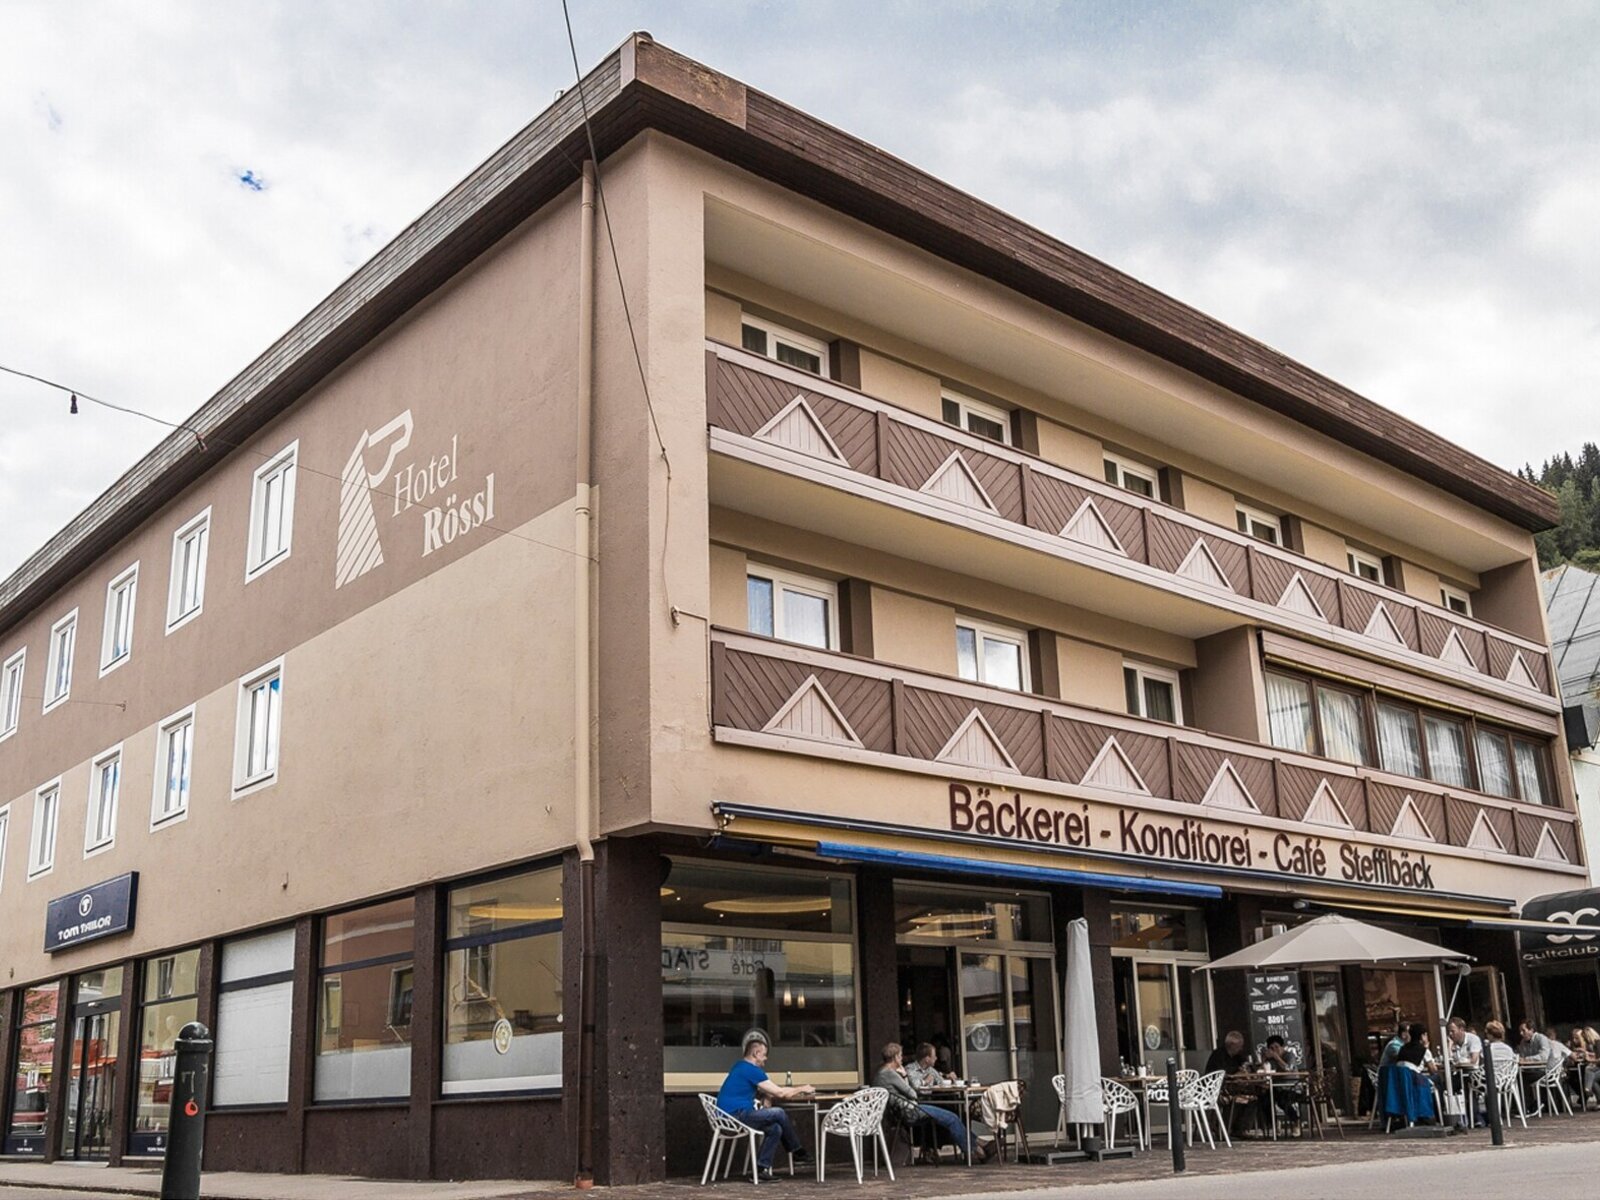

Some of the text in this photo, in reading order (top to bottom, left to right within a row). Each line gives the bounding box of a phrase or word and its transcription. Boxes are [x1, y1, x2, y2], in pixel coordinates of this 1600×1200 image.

[392, 434, 458, 518] Hotel
[421, 472, 495, 557] Rössl
[949, 783, 1091, 847] Bäckerei
[1119, 809, 1252, 867] Konditorei
[1274, 832, 1327, 876] Café
[1340, 843, 1434, 889] Stefflbäck
[58, 915, 112, 940] TOM TAILOR
[1522, 945, 1599, 960] cultclub
